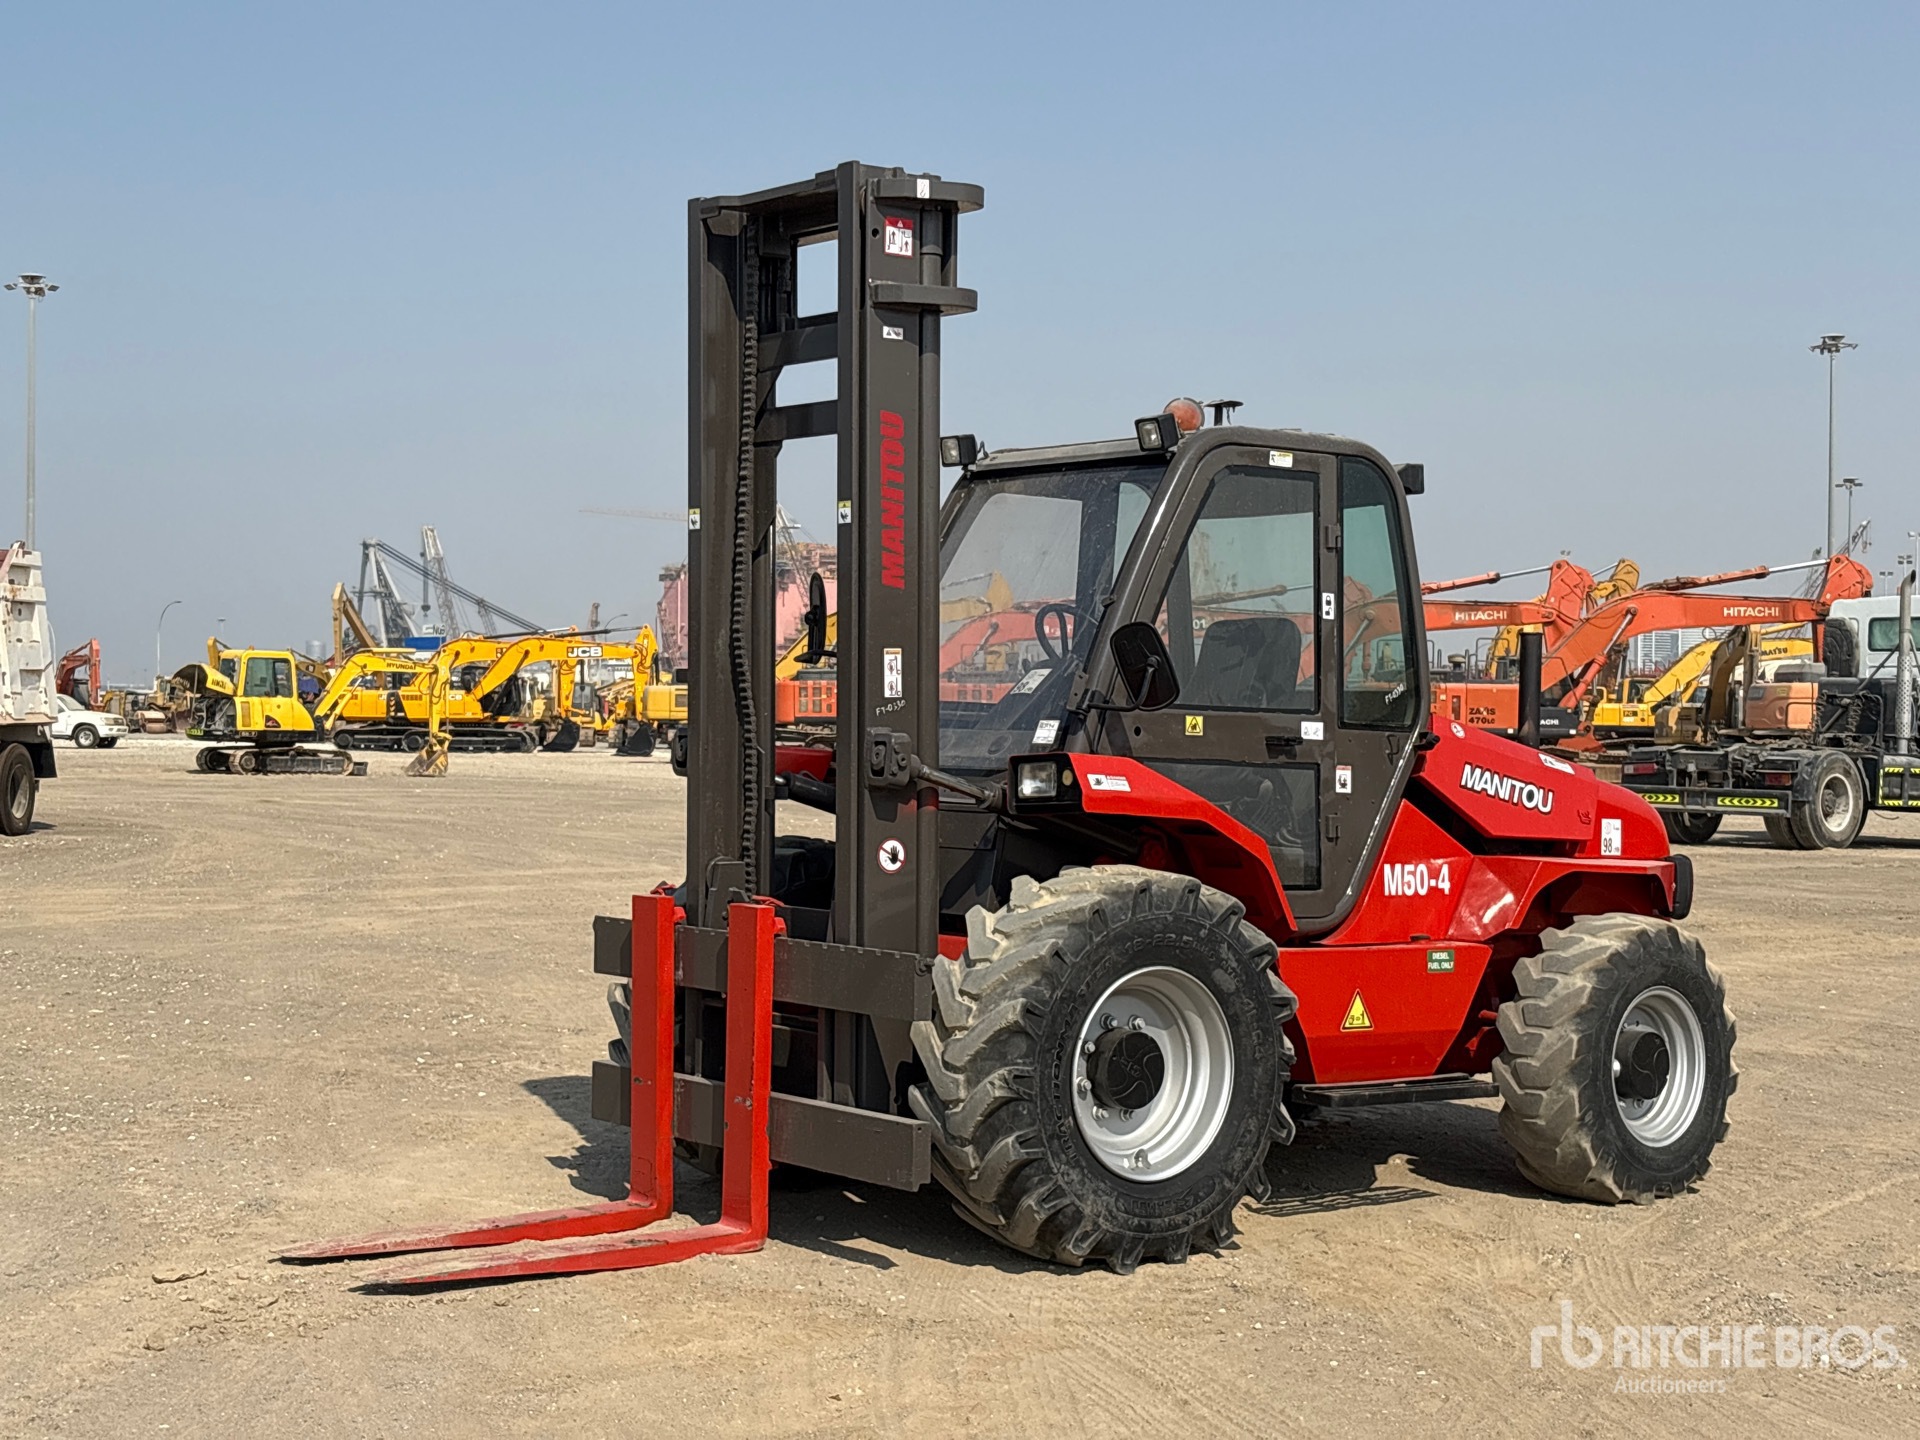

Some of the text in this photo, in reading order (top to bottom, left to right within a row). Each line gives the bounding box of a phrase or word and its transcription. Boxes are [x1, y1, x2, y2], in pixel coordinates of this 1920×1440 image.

[880, 410, 905, 590] MANITOU
[1455, 610, 1507, 620] HITACHI
[1723, 606, 1779, 617] HITACHI
[568, 647, 602, 657] JCB
[386, 662, 416, 670] HYUNDAI
[1460, 763, 1553, 814] MANITOU
[1603, 837, 1613, 853] 98
[1383, 863, 1451, 897] M50-4
[1432, 952, 1449, 960] DIESEL
[1441, 961, 1454, 969] ONLY
